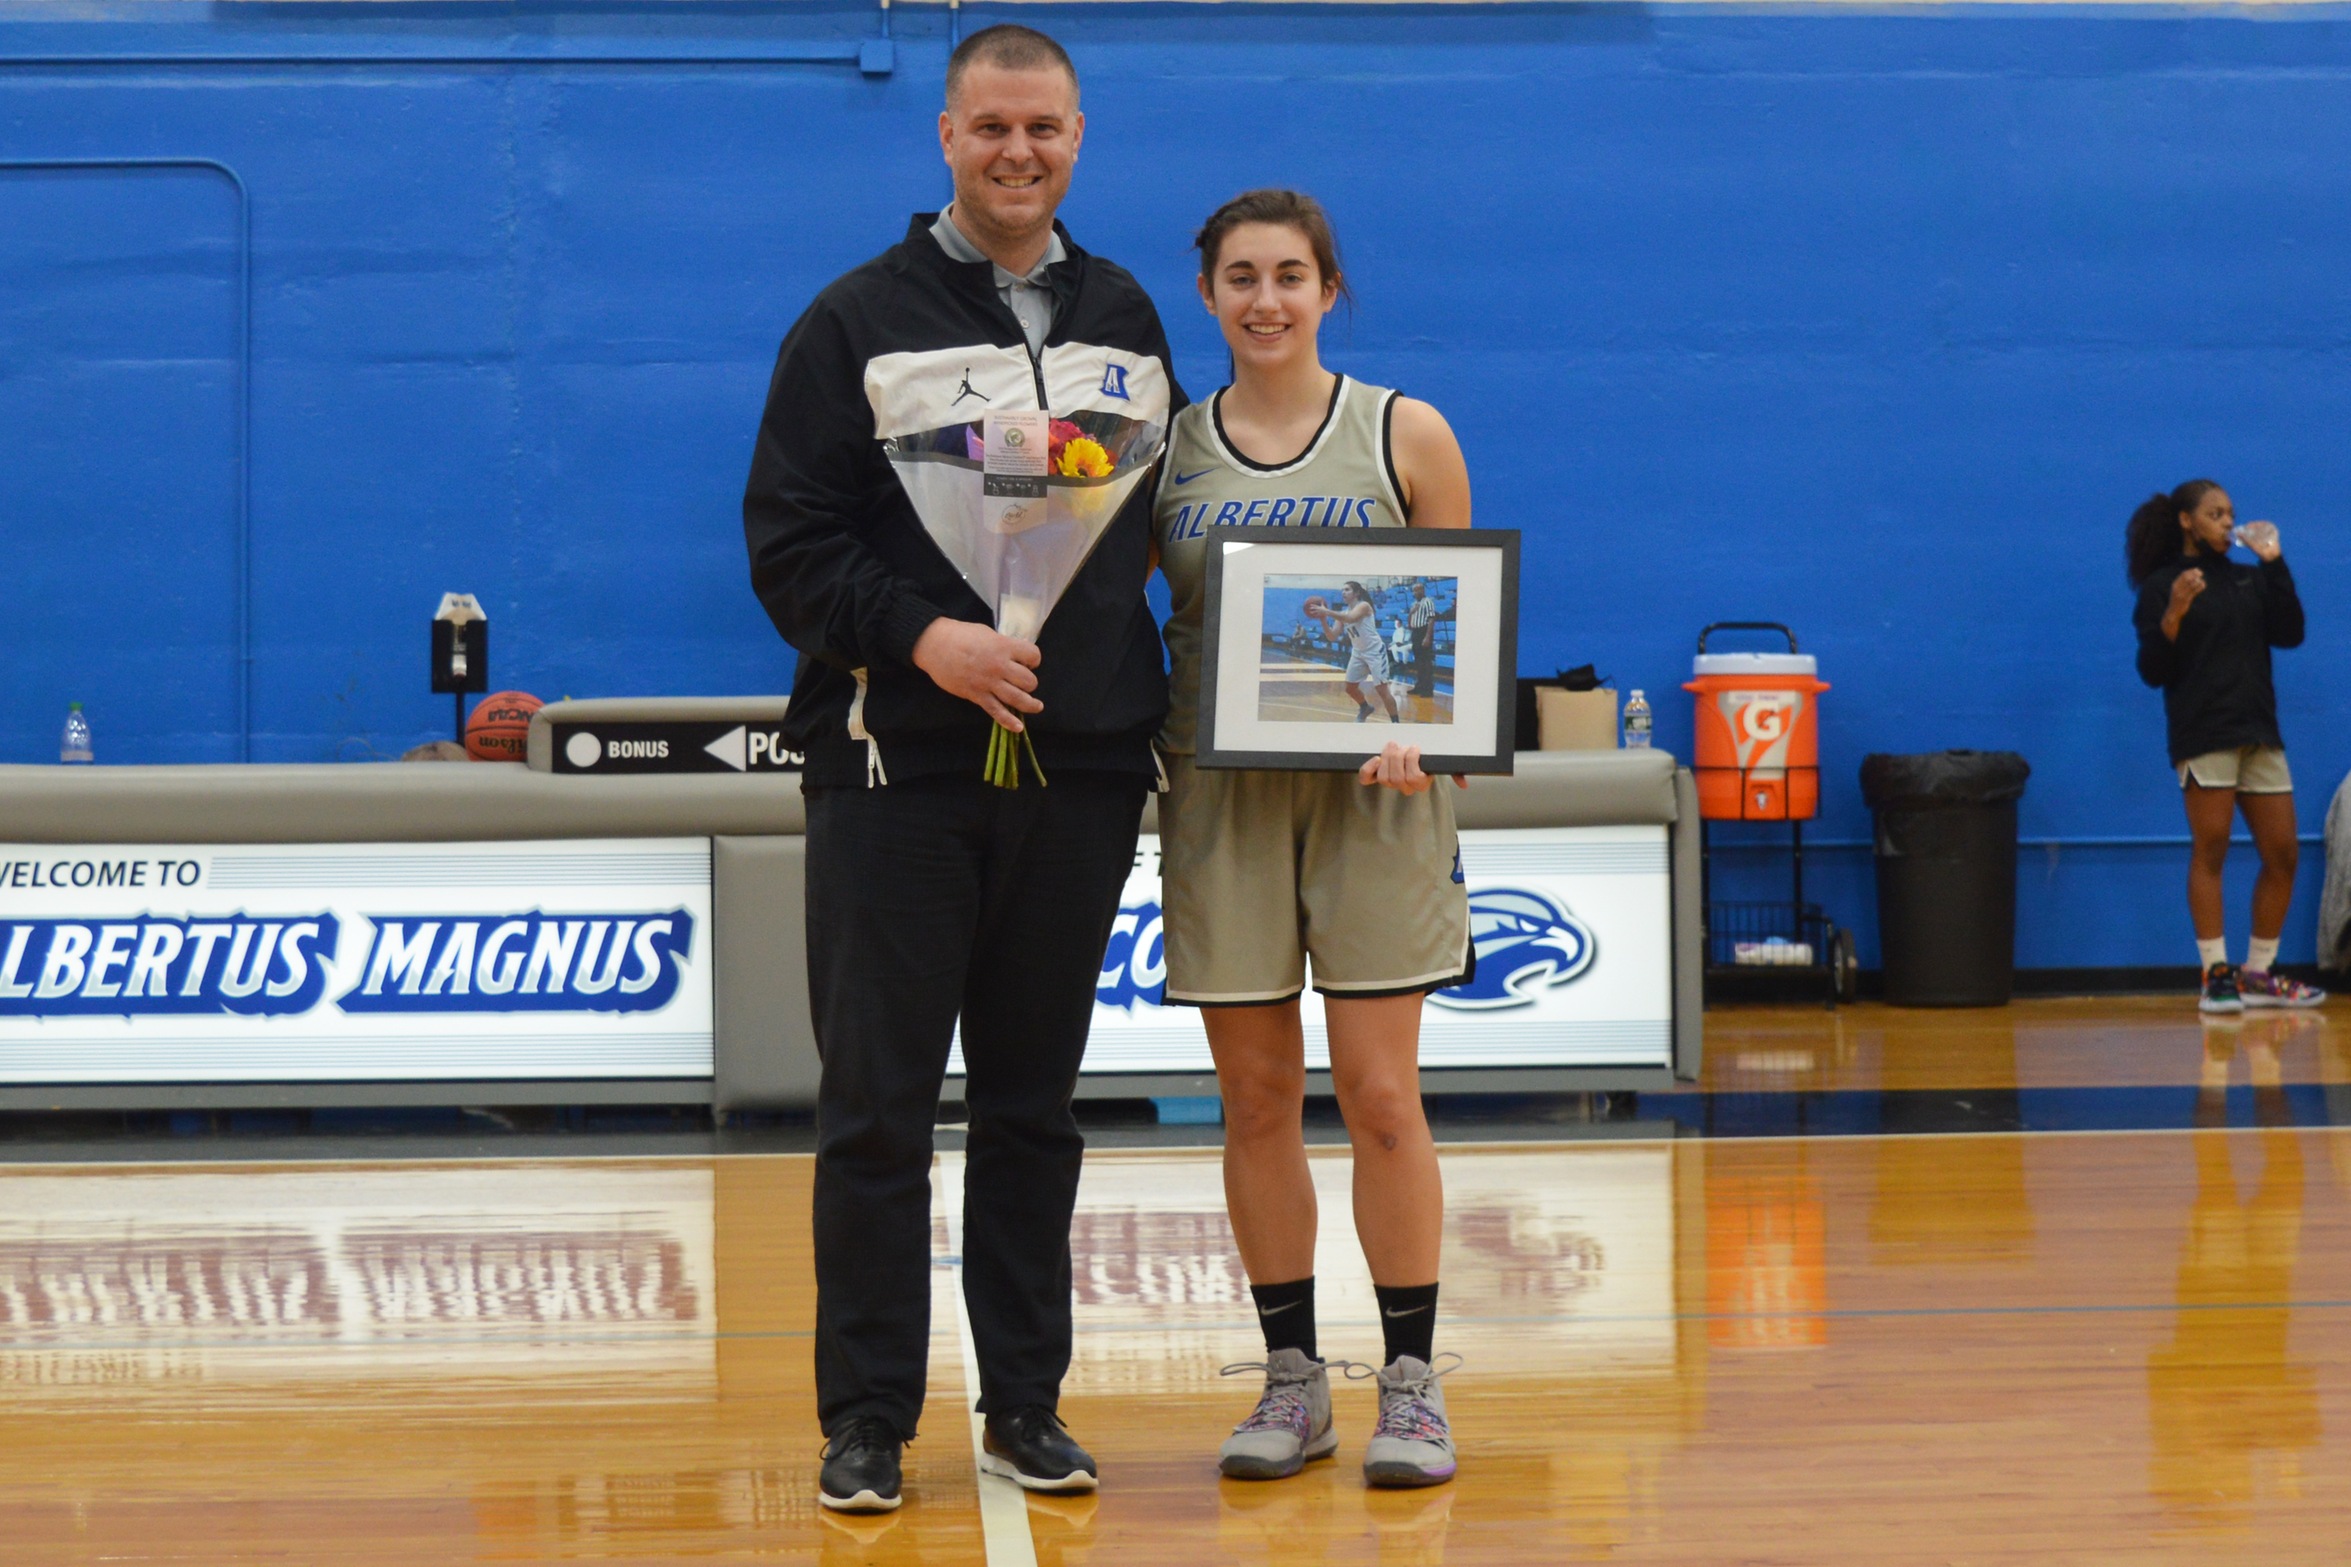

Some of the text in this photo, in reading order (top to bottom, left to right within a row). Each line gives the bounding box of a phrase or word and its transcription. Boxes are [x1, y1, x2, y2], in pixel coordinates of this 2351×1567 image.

[1742, 700, 1781, 740] G
[608, 740, 670, 758] BONUS
[158, 860, 201, 887] TO
[361, 918, 673, 995] MAGNUS
